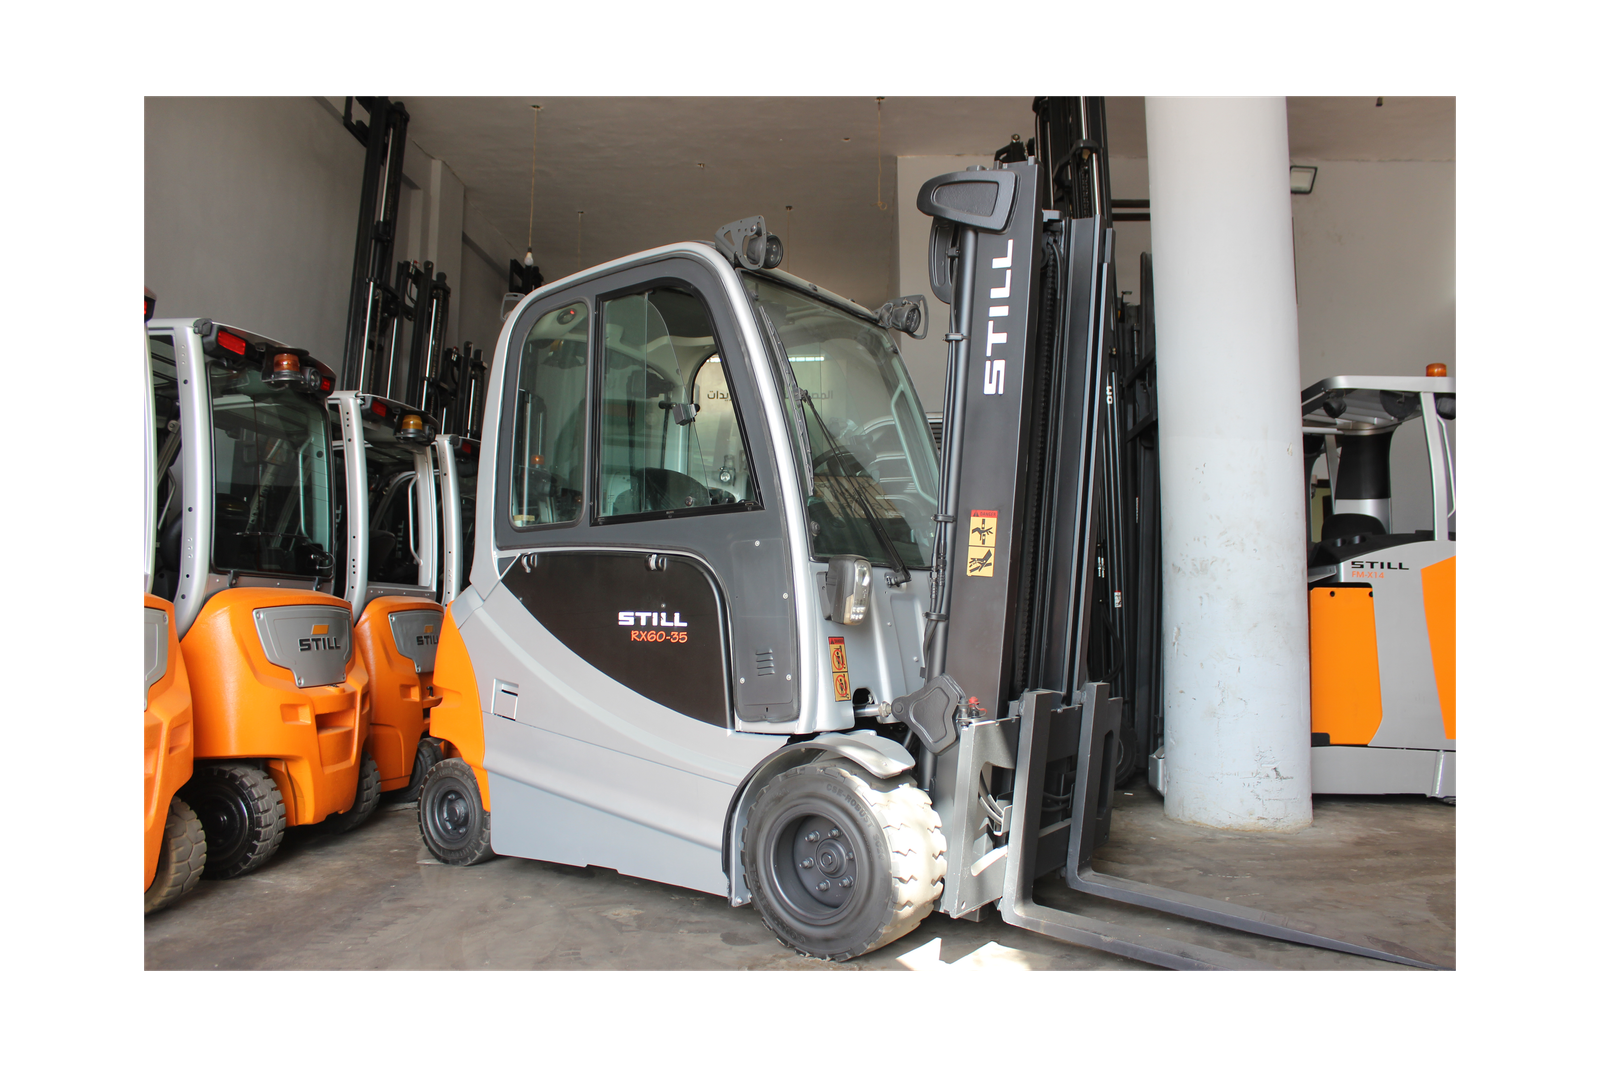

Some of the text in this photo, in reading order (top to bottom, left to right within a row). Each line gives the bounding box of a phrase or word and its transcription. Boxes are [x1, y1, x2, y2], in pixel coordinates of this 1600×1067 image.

[984, 238, 1014, 395] STILL
[1351, 561, 1410, 571] STILL
[1351, 571, 1385, 579] FM-X14
[618, 611, 688, 627] STILL
[630, 630, 688, 643] RX60-35
[298, 637, 341, 652] STILL
